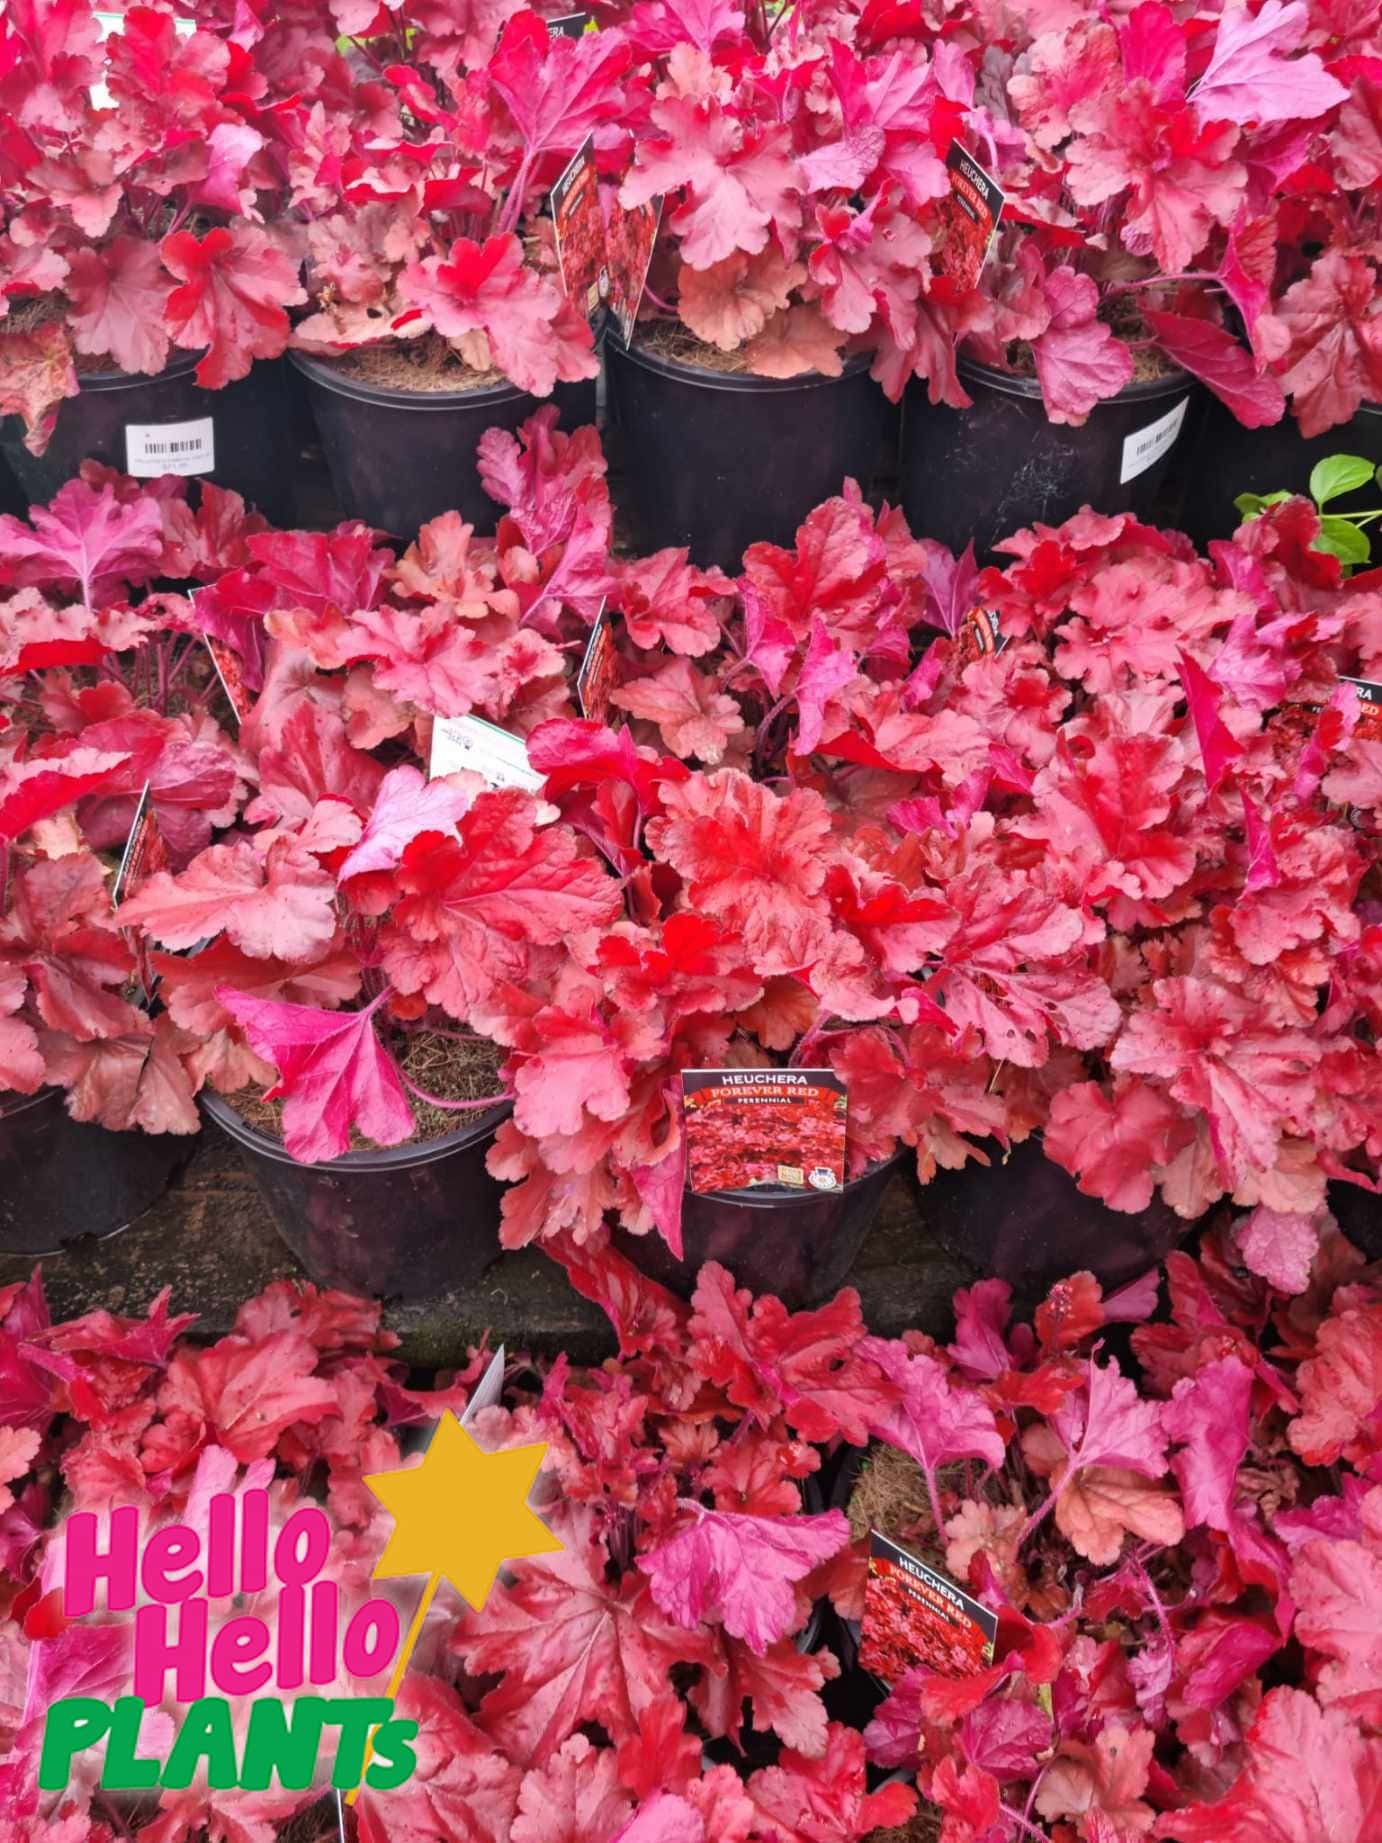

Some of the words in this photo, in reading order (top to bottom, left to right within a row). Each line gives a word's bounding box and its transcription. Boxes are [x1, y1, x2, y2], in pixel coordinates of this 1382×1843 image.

[960, 159, 990, 201] HEUCHERA
[711, 1086, 783, 1097] FOREVER
[786, 1087, 819, 1097] RED
[721, 1074, 808, 1085] HEUCHERA
[890, 1565, 945, 1607] FOREVER
[946, 1605, 973, 1629] RED
[899, 1556, 965, 1611] HEUCHERA
